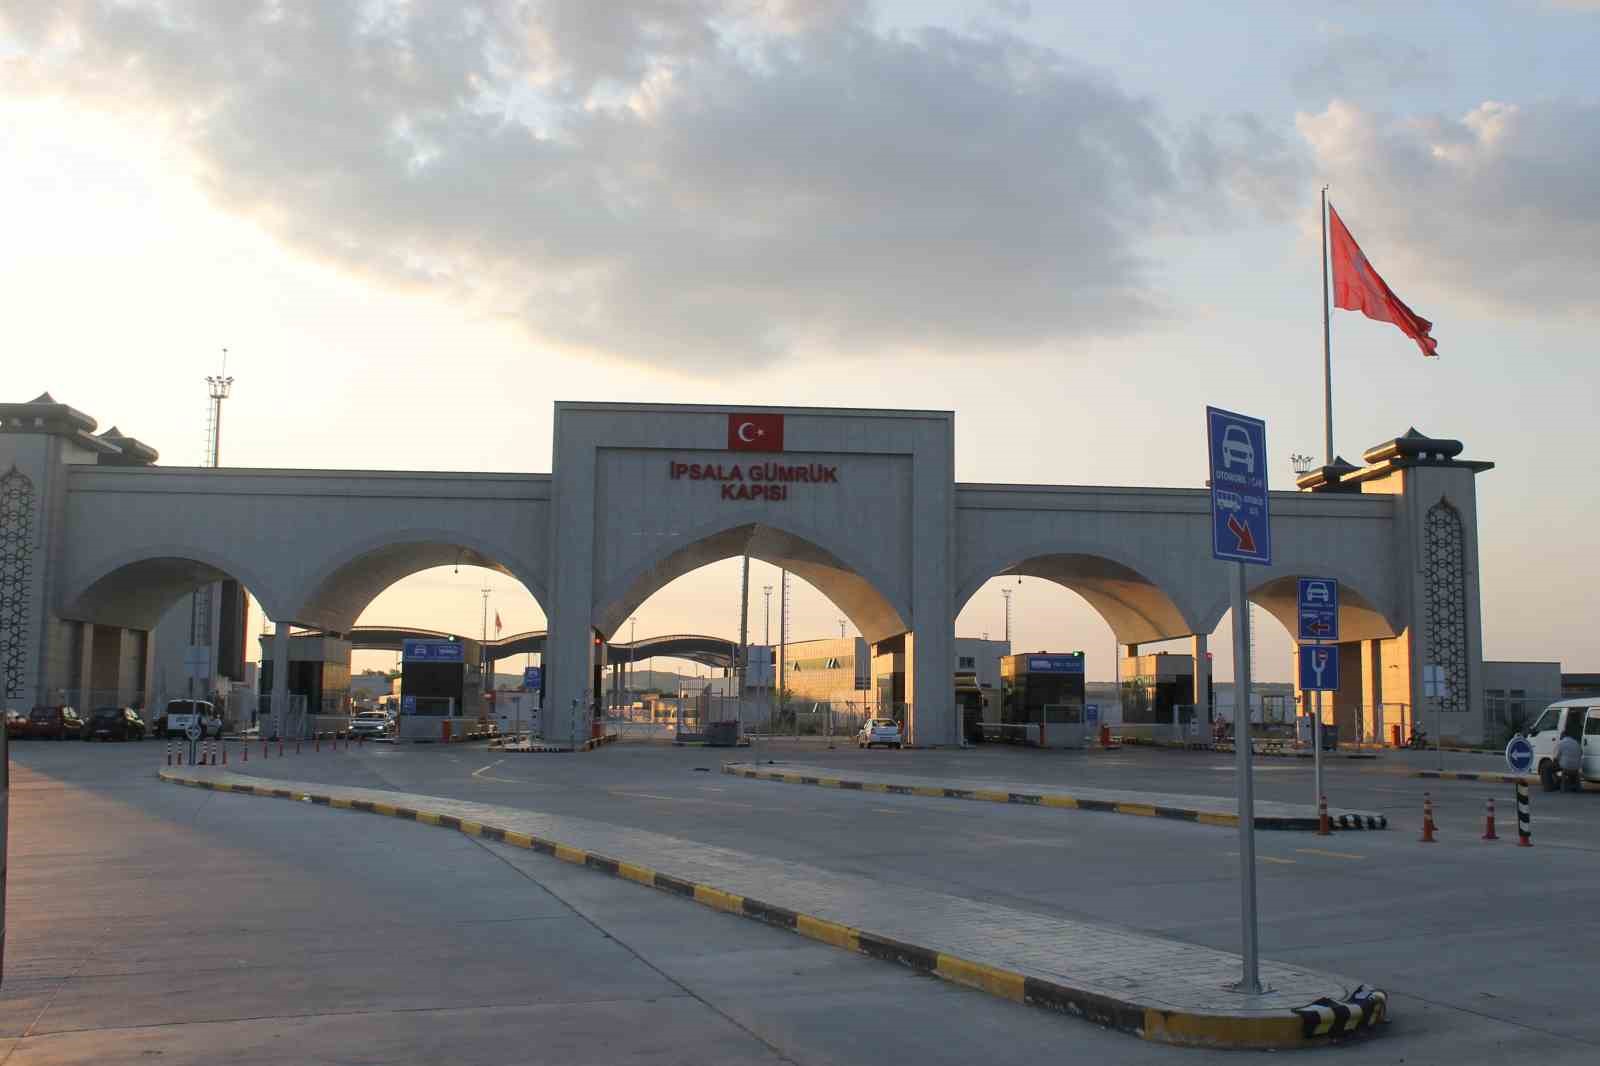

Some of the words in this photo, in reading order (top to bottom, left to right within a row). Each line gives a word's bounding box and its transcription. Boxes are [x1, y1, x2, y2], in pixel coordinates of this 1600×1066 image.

[669, 460, 743, 481] İPSALA
[749, 461, 838, 483] GÜMRÜK
[720, 483, 788, 501] KAPISI
